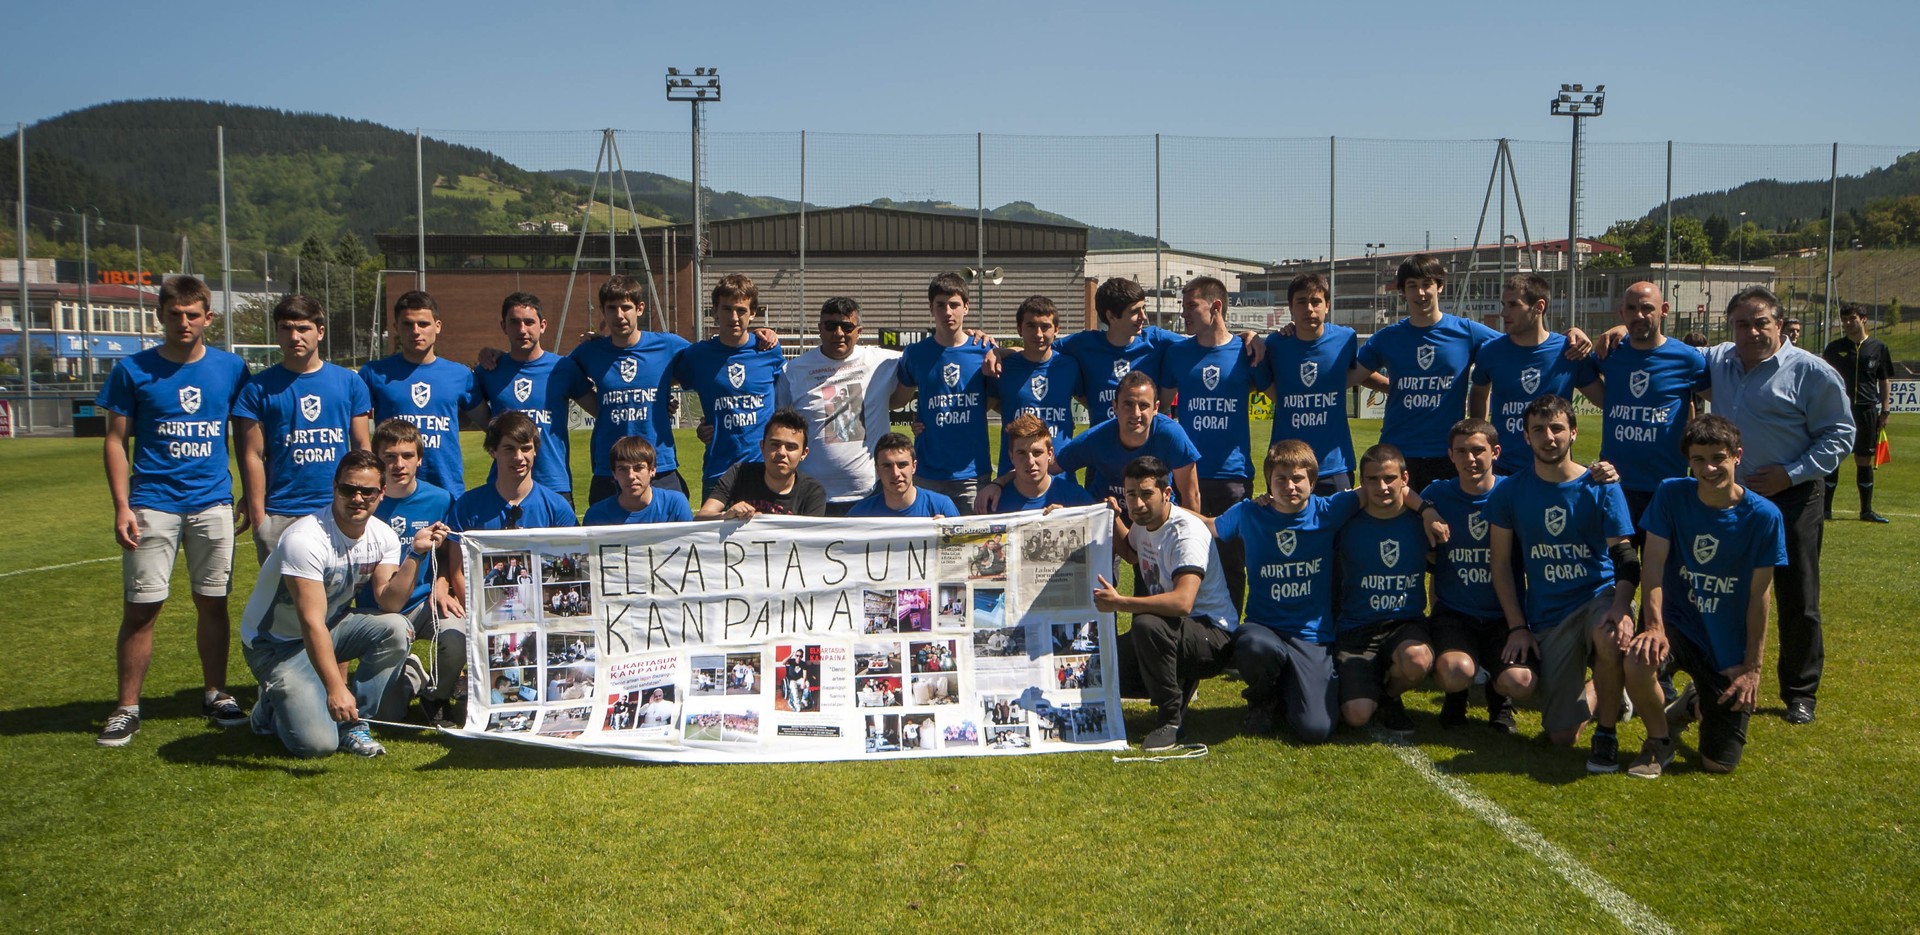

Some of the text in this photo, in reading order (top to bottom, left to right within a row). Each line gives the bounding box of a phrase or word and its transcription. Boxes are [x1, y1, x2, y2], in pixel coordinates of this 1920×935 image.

[97, 270, 152, 285] IBUC
[1398, 375, 1454, 390] AURTENE
[603, 388, 658, 404] AURTENE
[714, 394, 764, 411] AURTENE
[928, 392, 979, 409] AURTENE
[1188, 397, 1238, 412] AURTENE
[1284, 391, 1338, 408] AURTENE
[1404, 393, 1442, 409] GORA!
[611, 407, 648, 425] GORA!
[724, 412, 757, 430] GORA!
[936, 410, 970, 427] GORA!
[1193, 415, 1229, 431] GORA!
[1292, 411, 1327, 430] GORA!
[1609, 405, 1670, 424] AURTENE
[157, 421, 221, 437] AURTENE
[285, 428, 344, 446] AURTENE
[1615, 425, 1657, 442] GORA!
[169, 441, 212, 459] GORA!
[293, 447, 336, 465] GORA!
[1448, 548, 1491, 563] AURTE
[1531, 543, 1592, 560] AURTENE
[599, 540, 927, 596] ELKARTASUN
[1260, 558, 1322, 578] AURTENE
[1457, 568, 1491, 585] GOR
[1544, 563, 1588, 583] GORA!
[1361, 573, 1420, 590] AURTENE
[1271, 580, 1311, 601] GORA!
[1370, 592, 1408, 611] GORA!
[605, 589, 852, 655] KANPAINA
[610, 663, 676, 679] KANPAINA
[611, 656, 677, 671] ELKARTASUN
